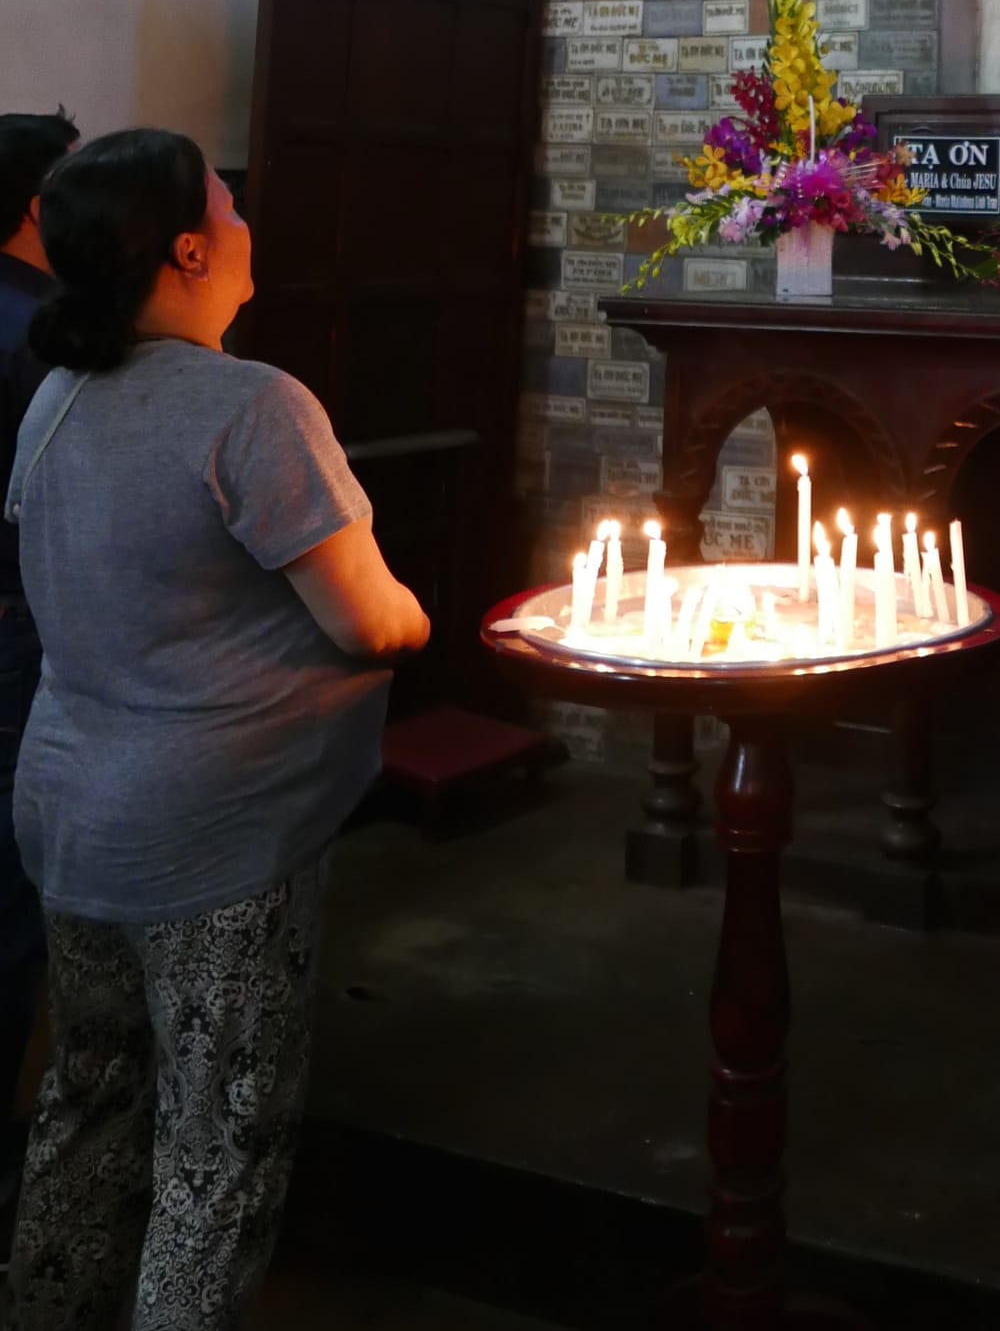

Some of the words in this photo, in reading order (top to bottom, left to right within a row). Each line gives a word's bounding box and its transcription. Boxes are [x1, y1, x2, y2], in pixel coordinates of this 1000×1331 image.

[949, 140, 990, 166] ƠN
[911, 172, 939, 189] MARIA
[973, 174, 998, 191] JESU
